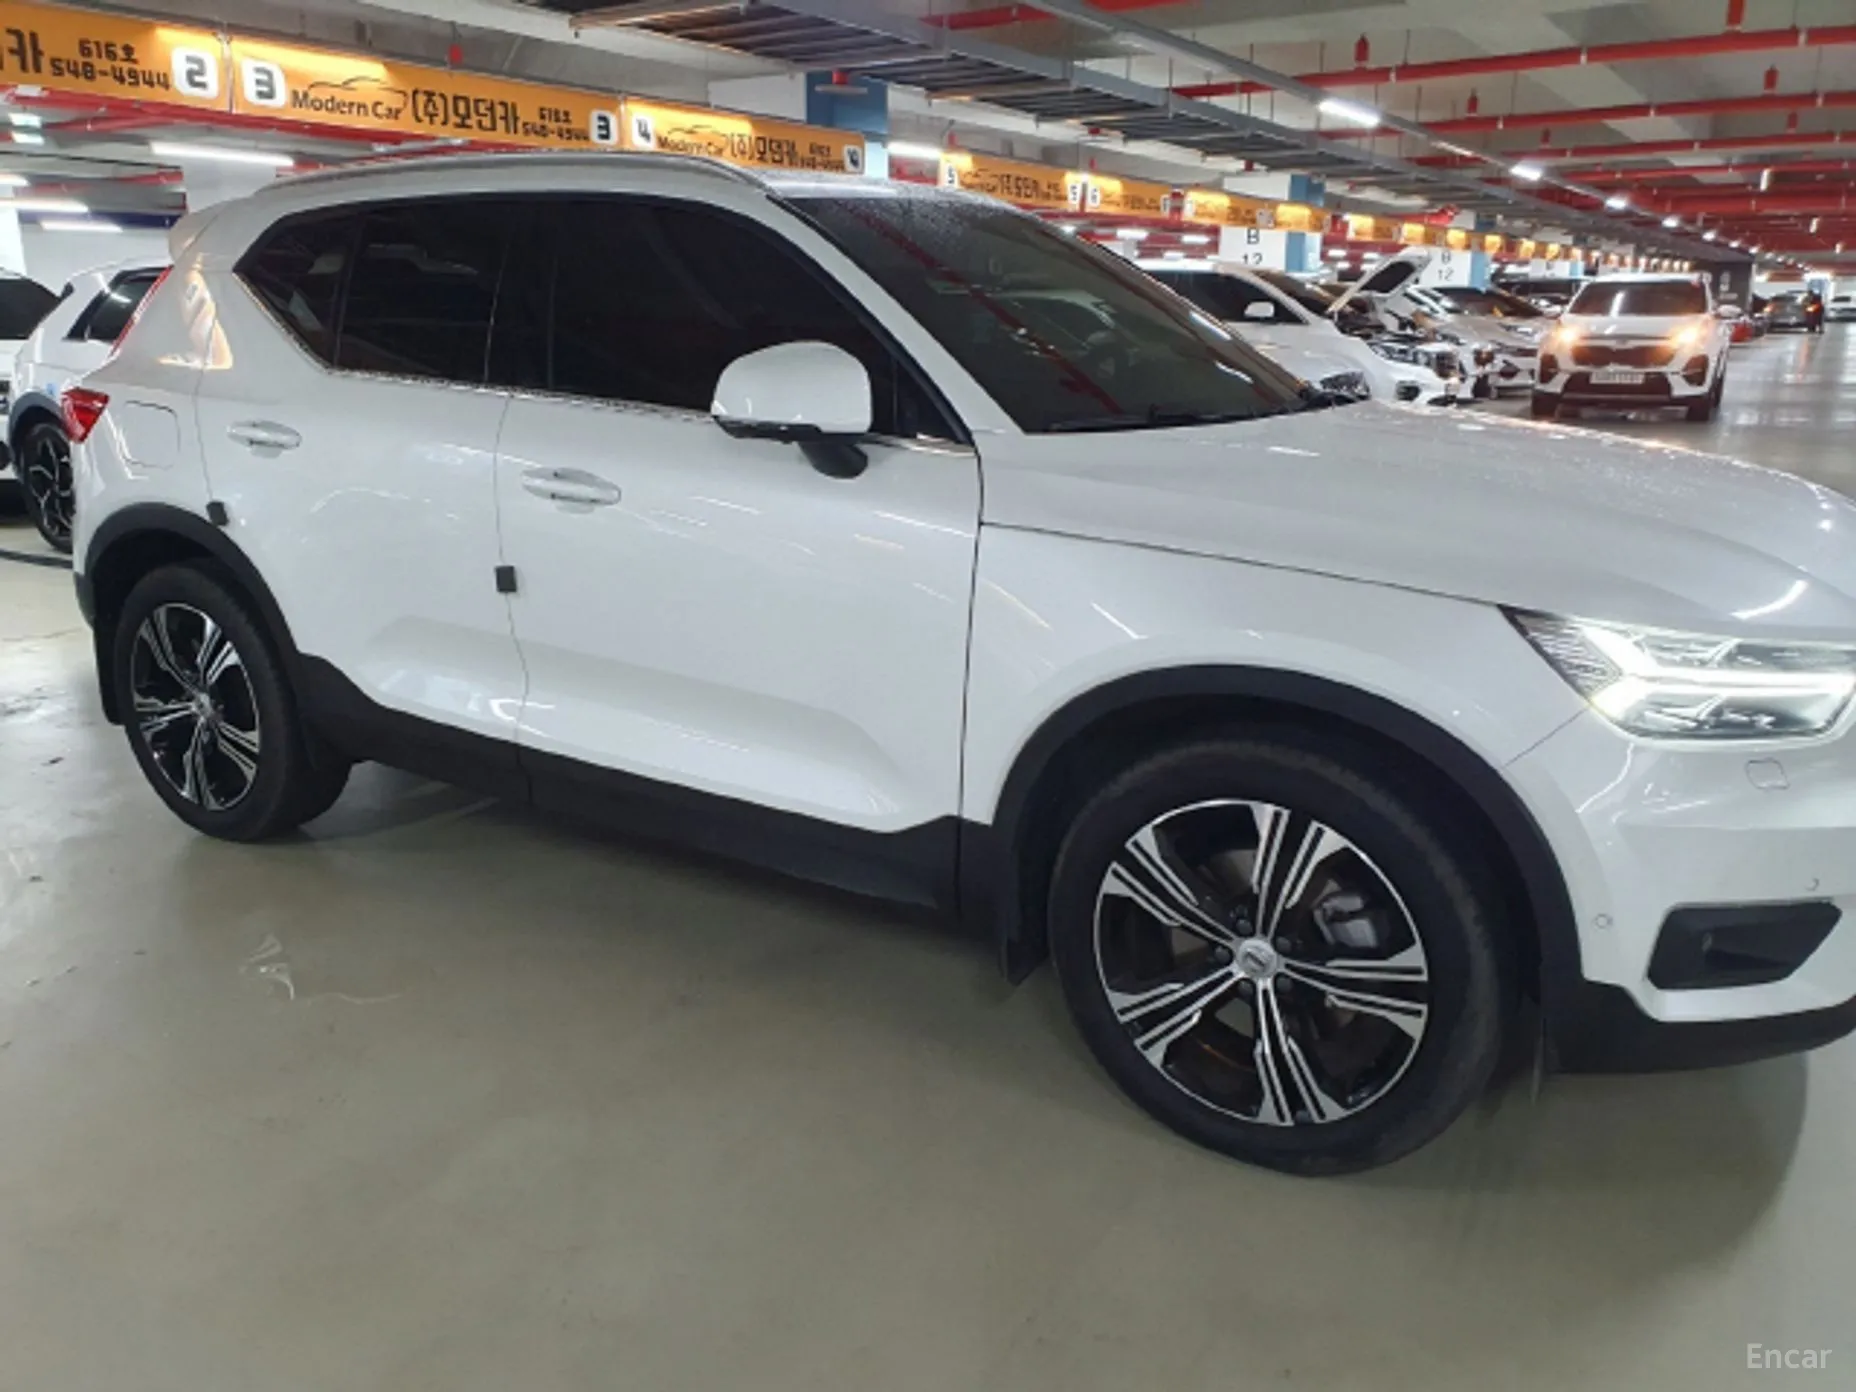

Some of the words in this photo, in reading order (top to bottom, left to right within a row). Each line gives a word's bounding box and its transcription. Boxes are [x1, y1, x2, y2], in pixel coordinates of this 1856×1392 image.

[79, 38, 139, 65] 616호
[50, 57, 170, 91] 548-4944
[185, 54, 208, 90] 2
[253, 66, 276, 99] 3
[291, 89, 369, 117] Modern
[371, 101, 402, 120] Car
[597, 115, 611, 140] 3
[1247, 227, 1260, 244] B
